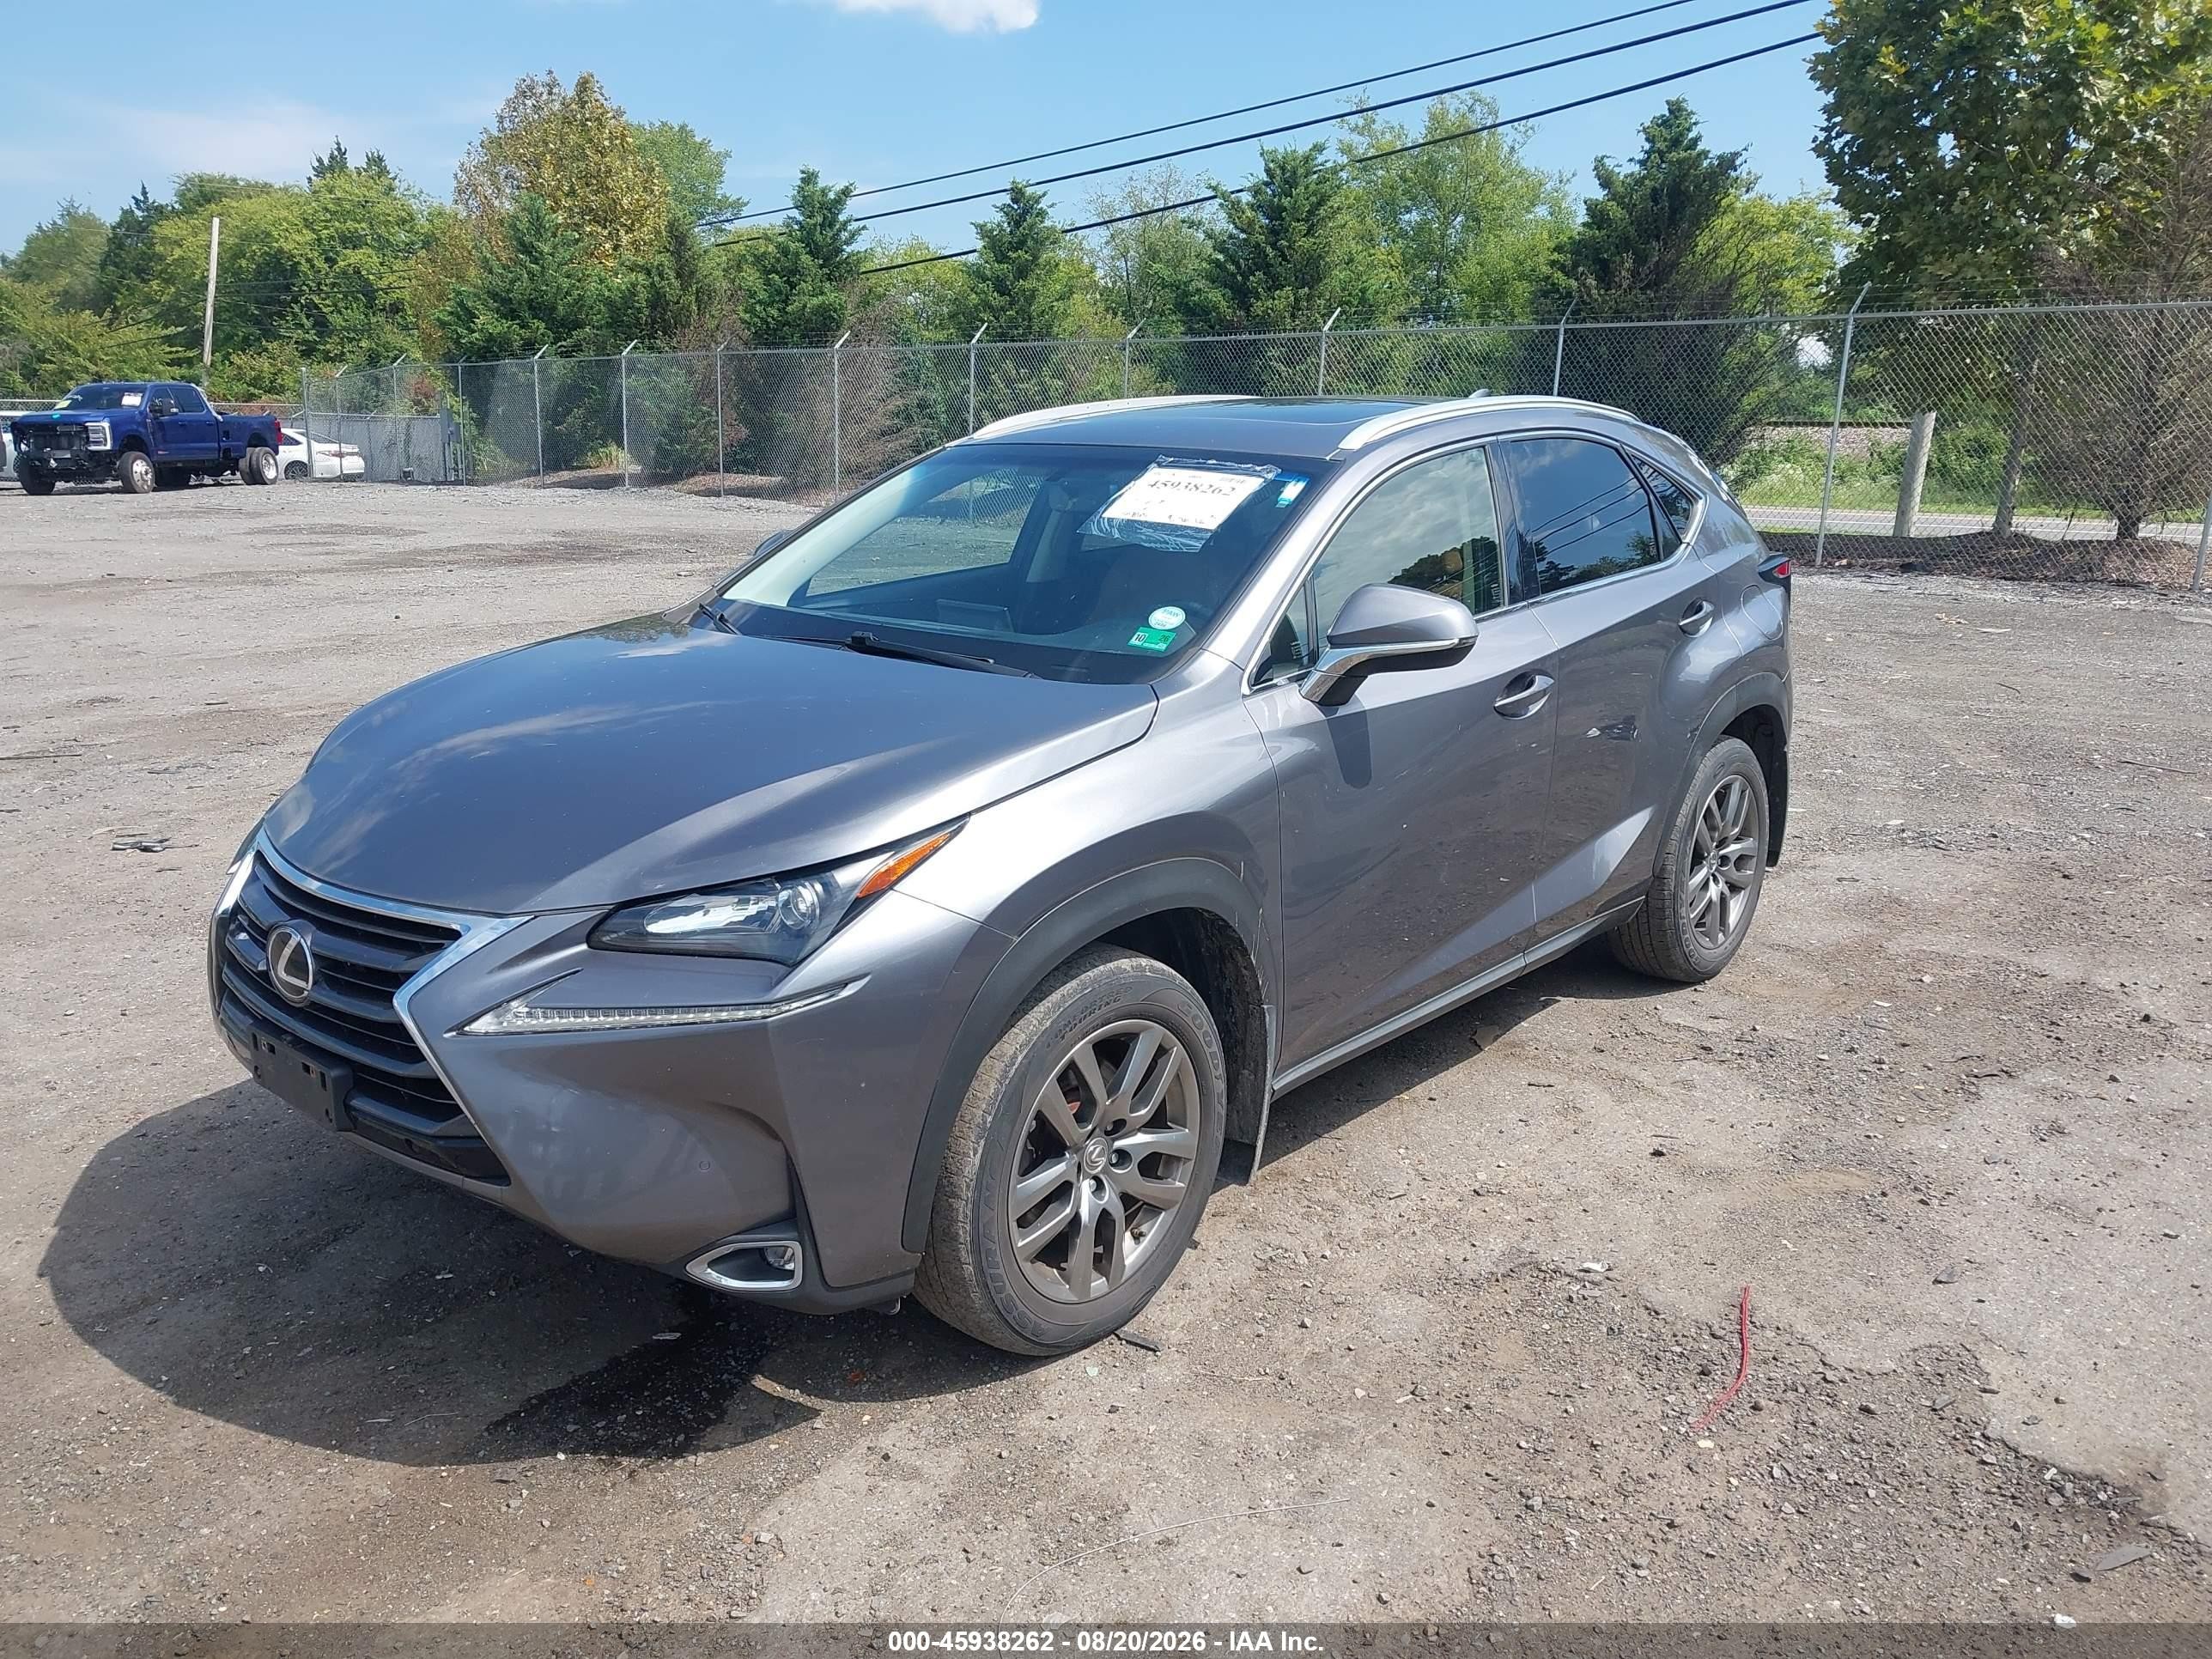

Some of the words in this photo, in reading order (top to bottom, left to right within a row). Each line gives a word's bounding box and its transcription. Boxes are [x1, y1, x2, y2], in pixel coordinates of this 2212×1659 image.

[1147, 480, 1237, 497] 45938262
[1134, 634, 1146, 642] 10
[1176, 1001, 1224, 1151] GOODYE
